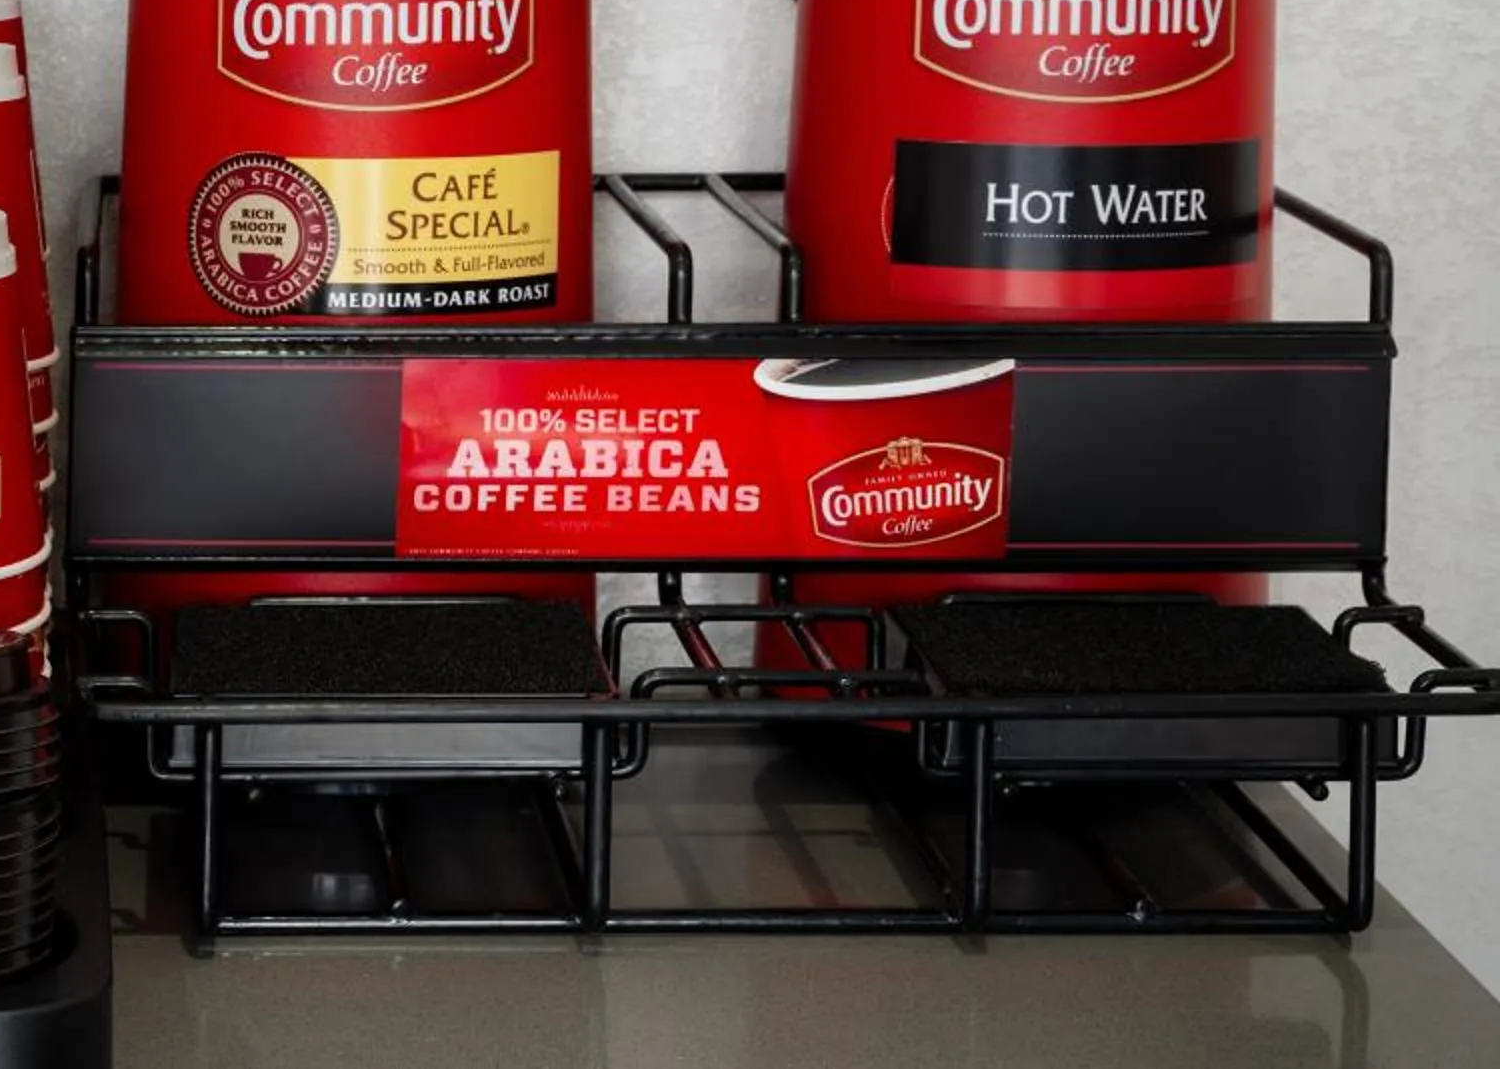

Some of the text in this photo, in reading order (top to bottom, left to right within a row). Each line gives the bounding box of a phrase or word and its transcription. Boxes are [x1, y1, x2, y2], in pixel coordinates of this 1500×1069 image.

[332, 52, 428, 93] Coffee
[1038, 42, 1136, 84] Coffee
[206, 170, 319, 218] 100% SELECT
[412, 168, 498, 203] CAFÉ
[241, 208, 275, 221] RICH
[984, 182, 1209, 226] HOT WATER
[229, 220, 287, 234] SMOOTH
[231, 234, 284, 247] FLAVOR
[201, 234, 323, 302] ARABICA COFFEE
[353, 252, 546, 276] Smooth & Full-Flavored
[327, 283, 551, 310] MEDIUM-DARK ROAST
[478, 407, 701, 434] 100% SELECT
[445, 438, 729, 479] ARABICA
[413, 484, 761, 513] COFFEE BEANS
[821, 472, 993, 528] Community
[881, 514, 934, 537] Coffee
